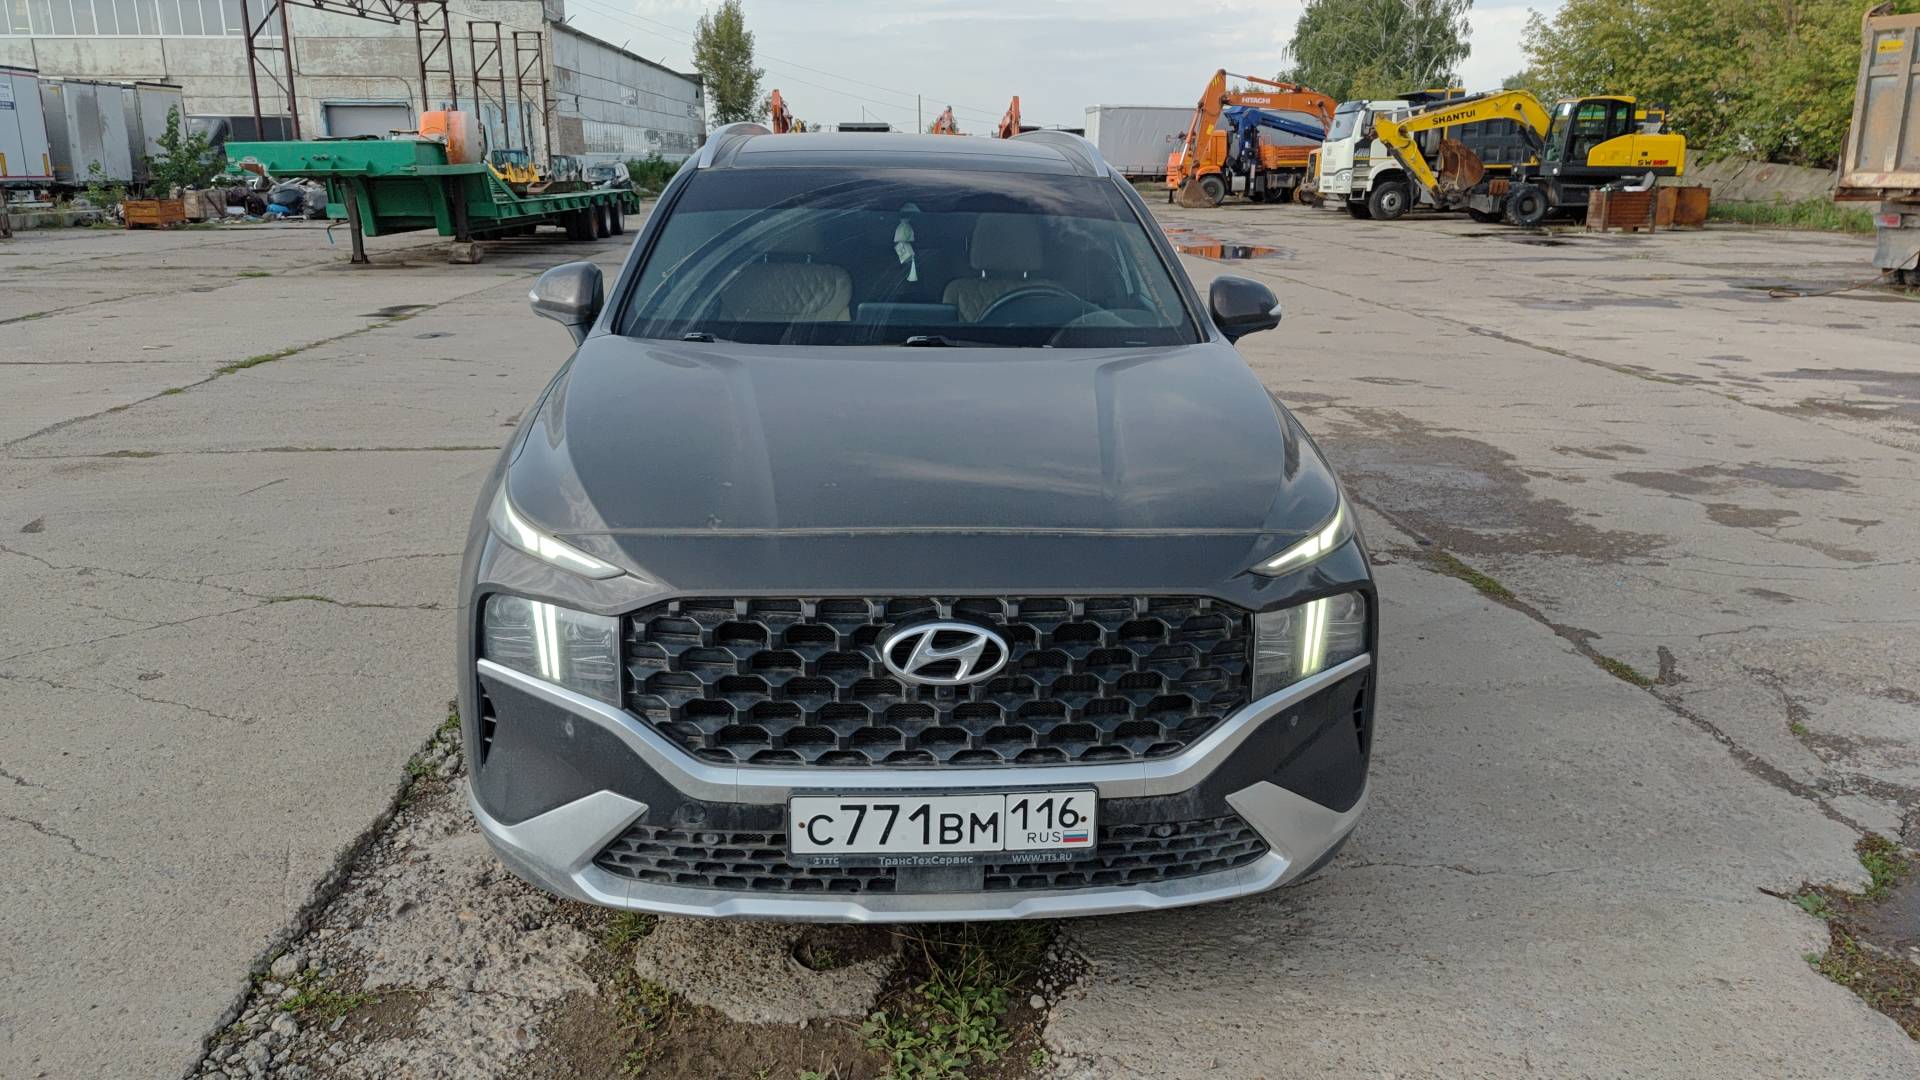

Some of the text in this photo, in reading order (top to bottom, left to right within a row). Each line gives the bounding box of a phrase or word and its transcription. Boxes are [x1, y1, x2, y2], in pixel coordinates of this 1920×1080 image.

[1432, 109, 1476, 125] SHANTUI
[1011, 797, 1079, 830] 116
[1027, 832, 1061, 843] RUS
[879, 856, 974, 867] ТрансТехСервис
